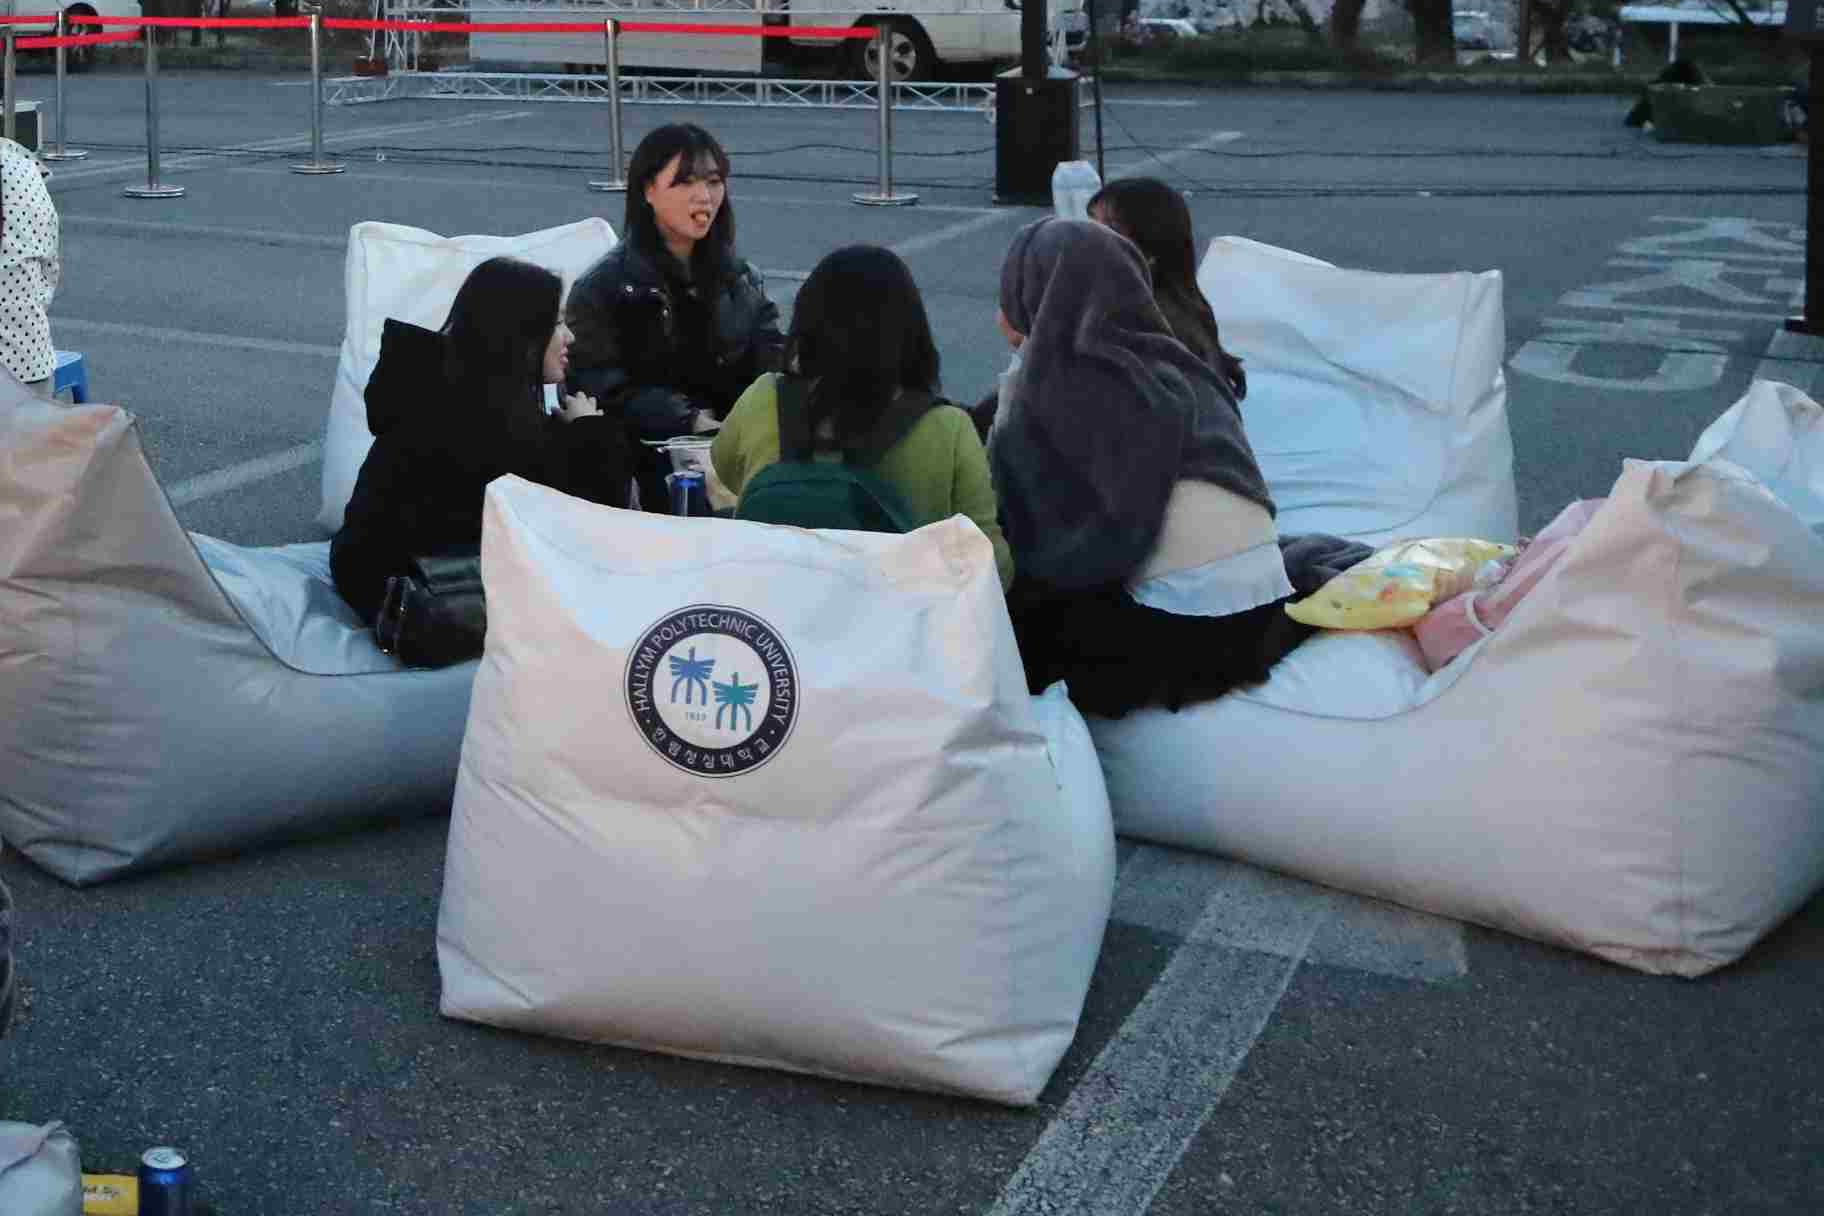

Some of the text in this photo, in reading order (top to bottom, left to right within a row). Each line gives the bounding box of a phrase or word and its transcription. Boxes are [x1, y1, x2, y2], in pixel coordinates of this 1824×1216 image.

[633, 613, 792, 725] HALLYM POLYTECHNIC UNIVERSITY
